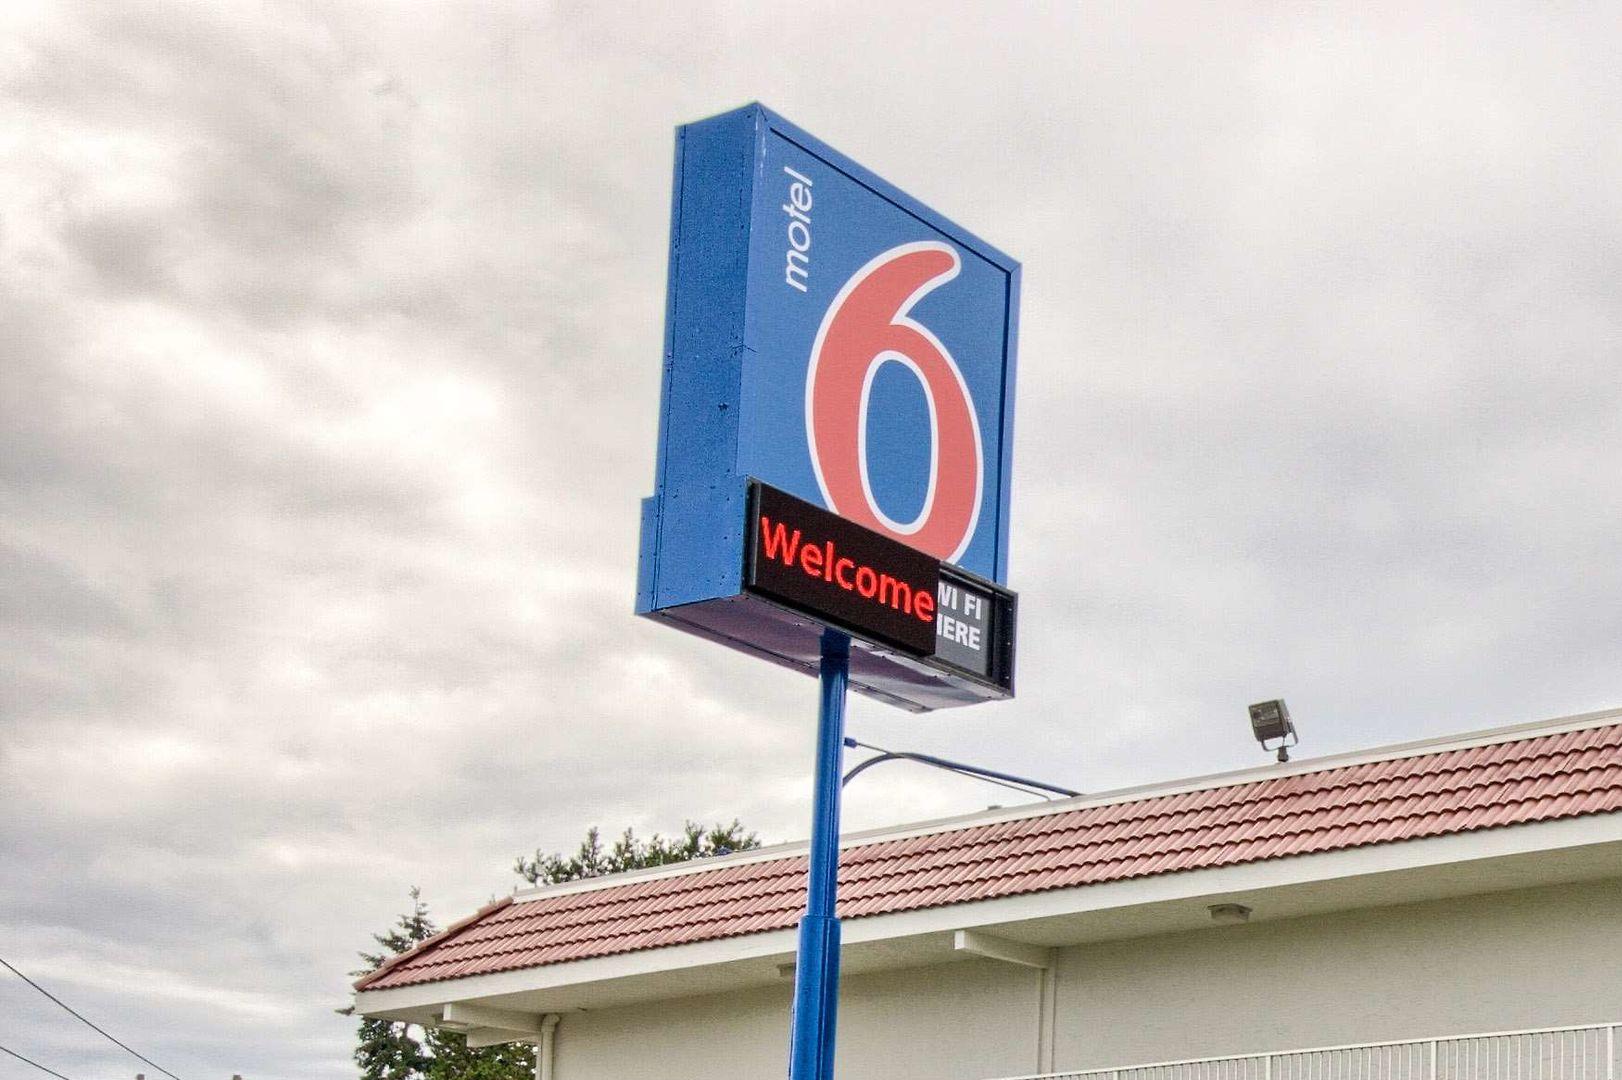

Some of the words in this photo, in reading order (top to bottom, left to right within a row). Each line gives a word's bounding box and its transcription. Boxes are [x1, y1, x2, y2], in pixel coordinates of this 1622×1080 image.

[783, 166, 813, 293] motel
[805, 240, 984, 567] 6
[761, 516, 935, 622] Welcome
[964, 593, 981, 620] FI
